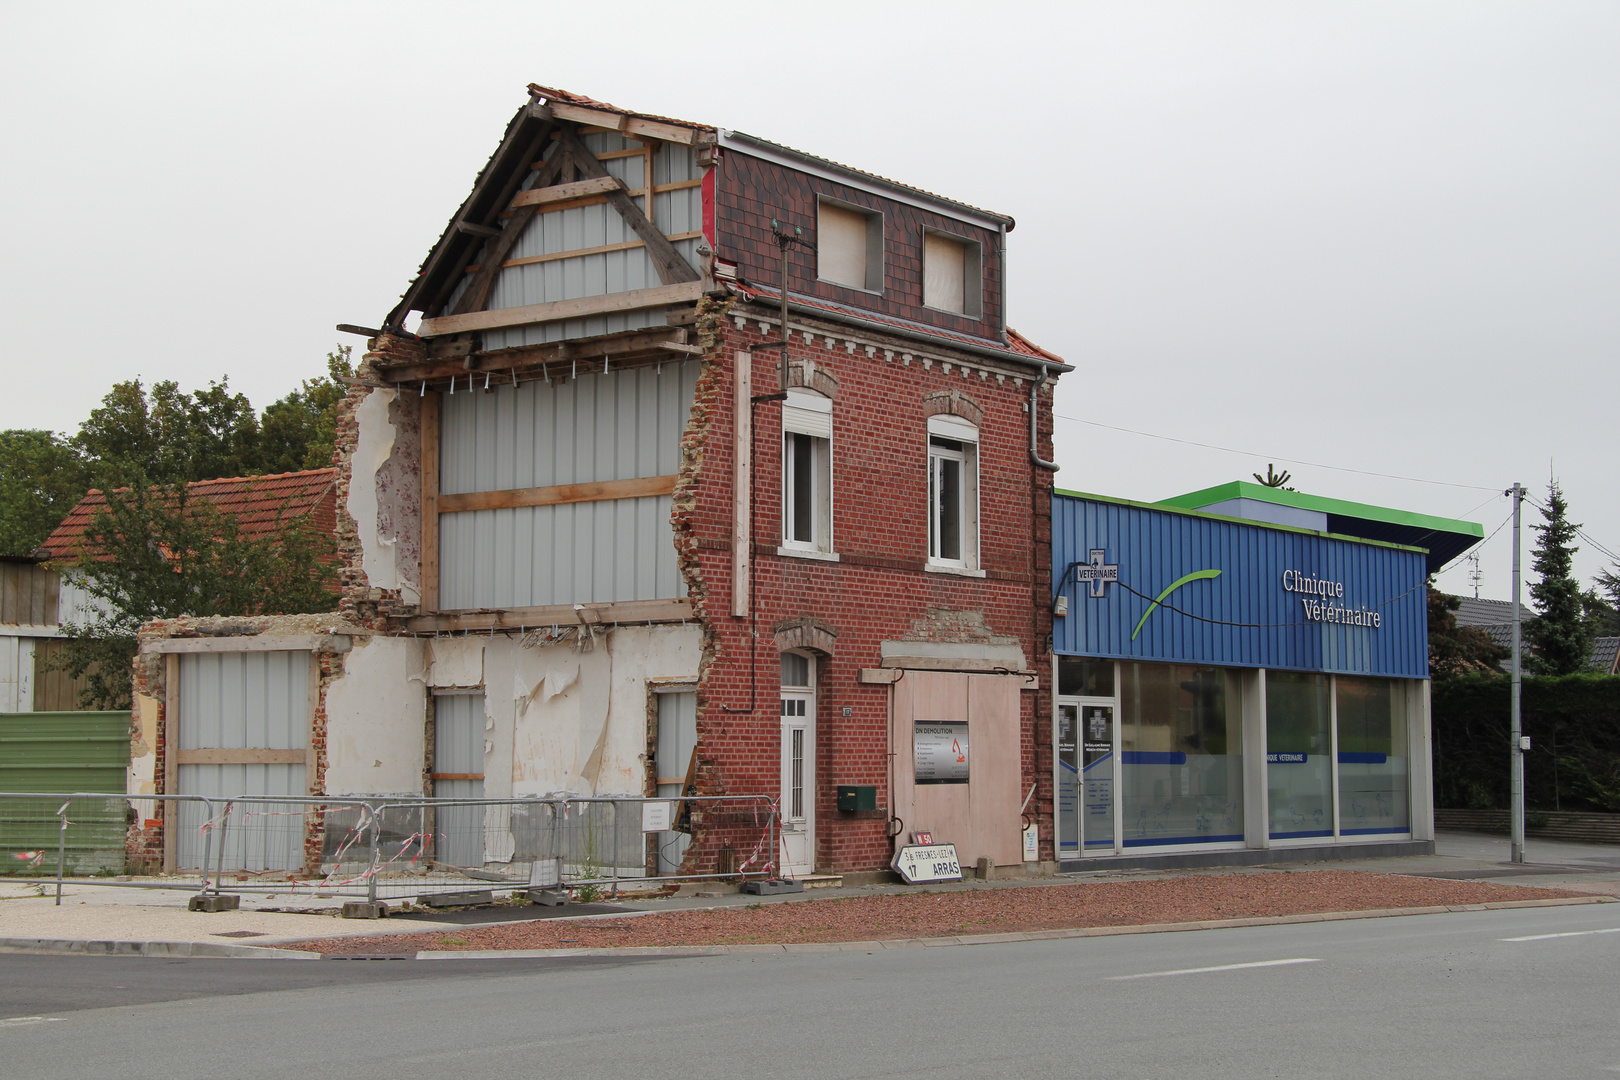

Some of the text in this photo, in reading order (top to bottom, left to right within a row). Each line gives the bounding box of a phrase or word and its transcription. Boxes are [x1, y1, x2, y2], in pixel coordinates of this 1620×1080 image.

[1283, 569, 1343, 601] Clinique
[1302, 598, 1381, 628] Vétérinaire
[917, 834, 932, 844] N 50
[908, 861, 960, 878] 17 ARRAS
